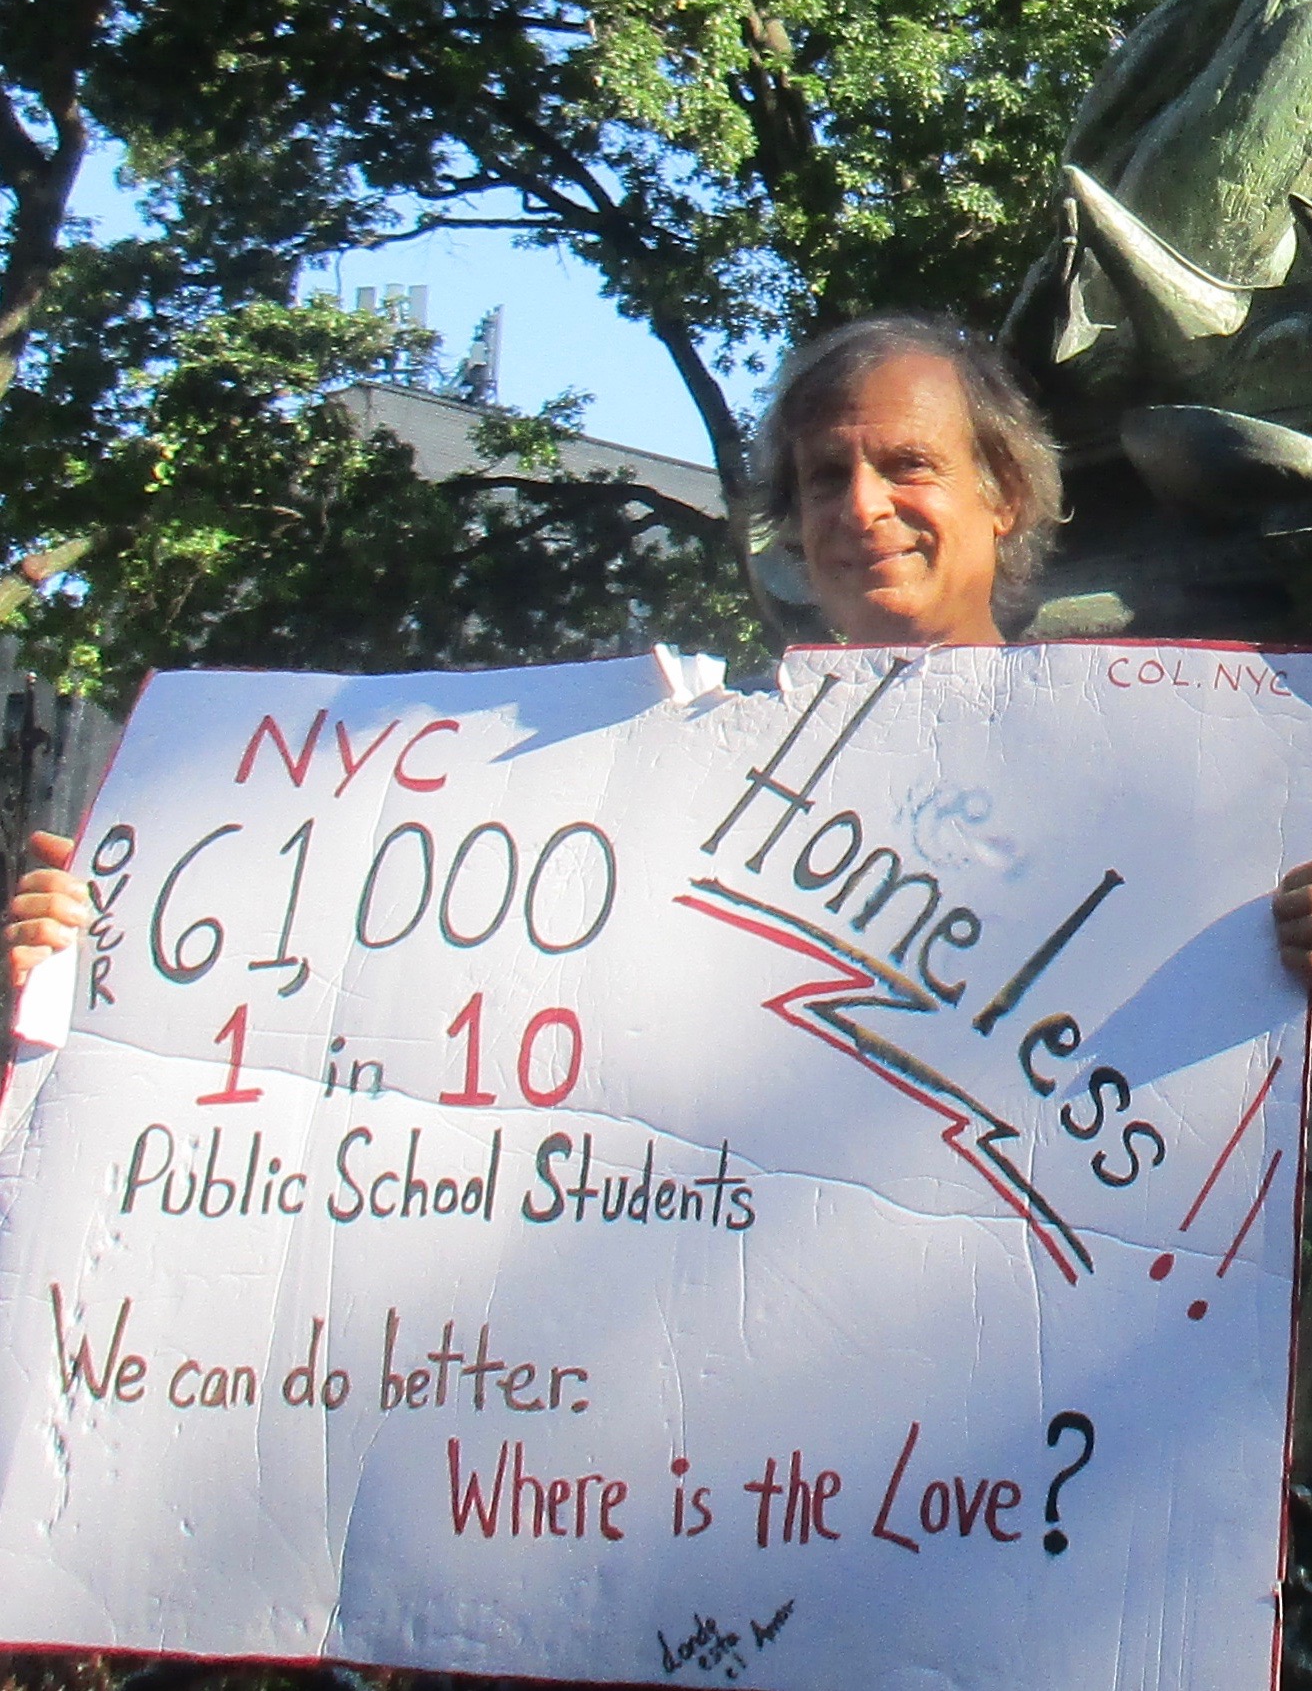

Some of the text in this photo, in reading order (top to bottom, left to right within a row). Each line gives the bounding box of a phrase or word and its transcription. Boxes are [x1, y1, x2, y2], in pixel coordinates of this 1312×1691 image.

[1108, 658, 1291, 695] COL. NYC
[235, 709, 459, 797] NYC
[88, 824, 135, 1009] OVER
[151, 817, 616, 998] 61,000
[196, 992, 582, 1107] 1 in 10
[121, 1123, 756, 1231] Public School Students
[50, 1282, 147, 1403] We
[169, 1359, 257, 1408] can
[282, 1316, 350, 1408] do
[447, 1438, 628, 1540] Where
[670, 1458, 712, 1537] is
[744, 1450, 842, 1548] the
